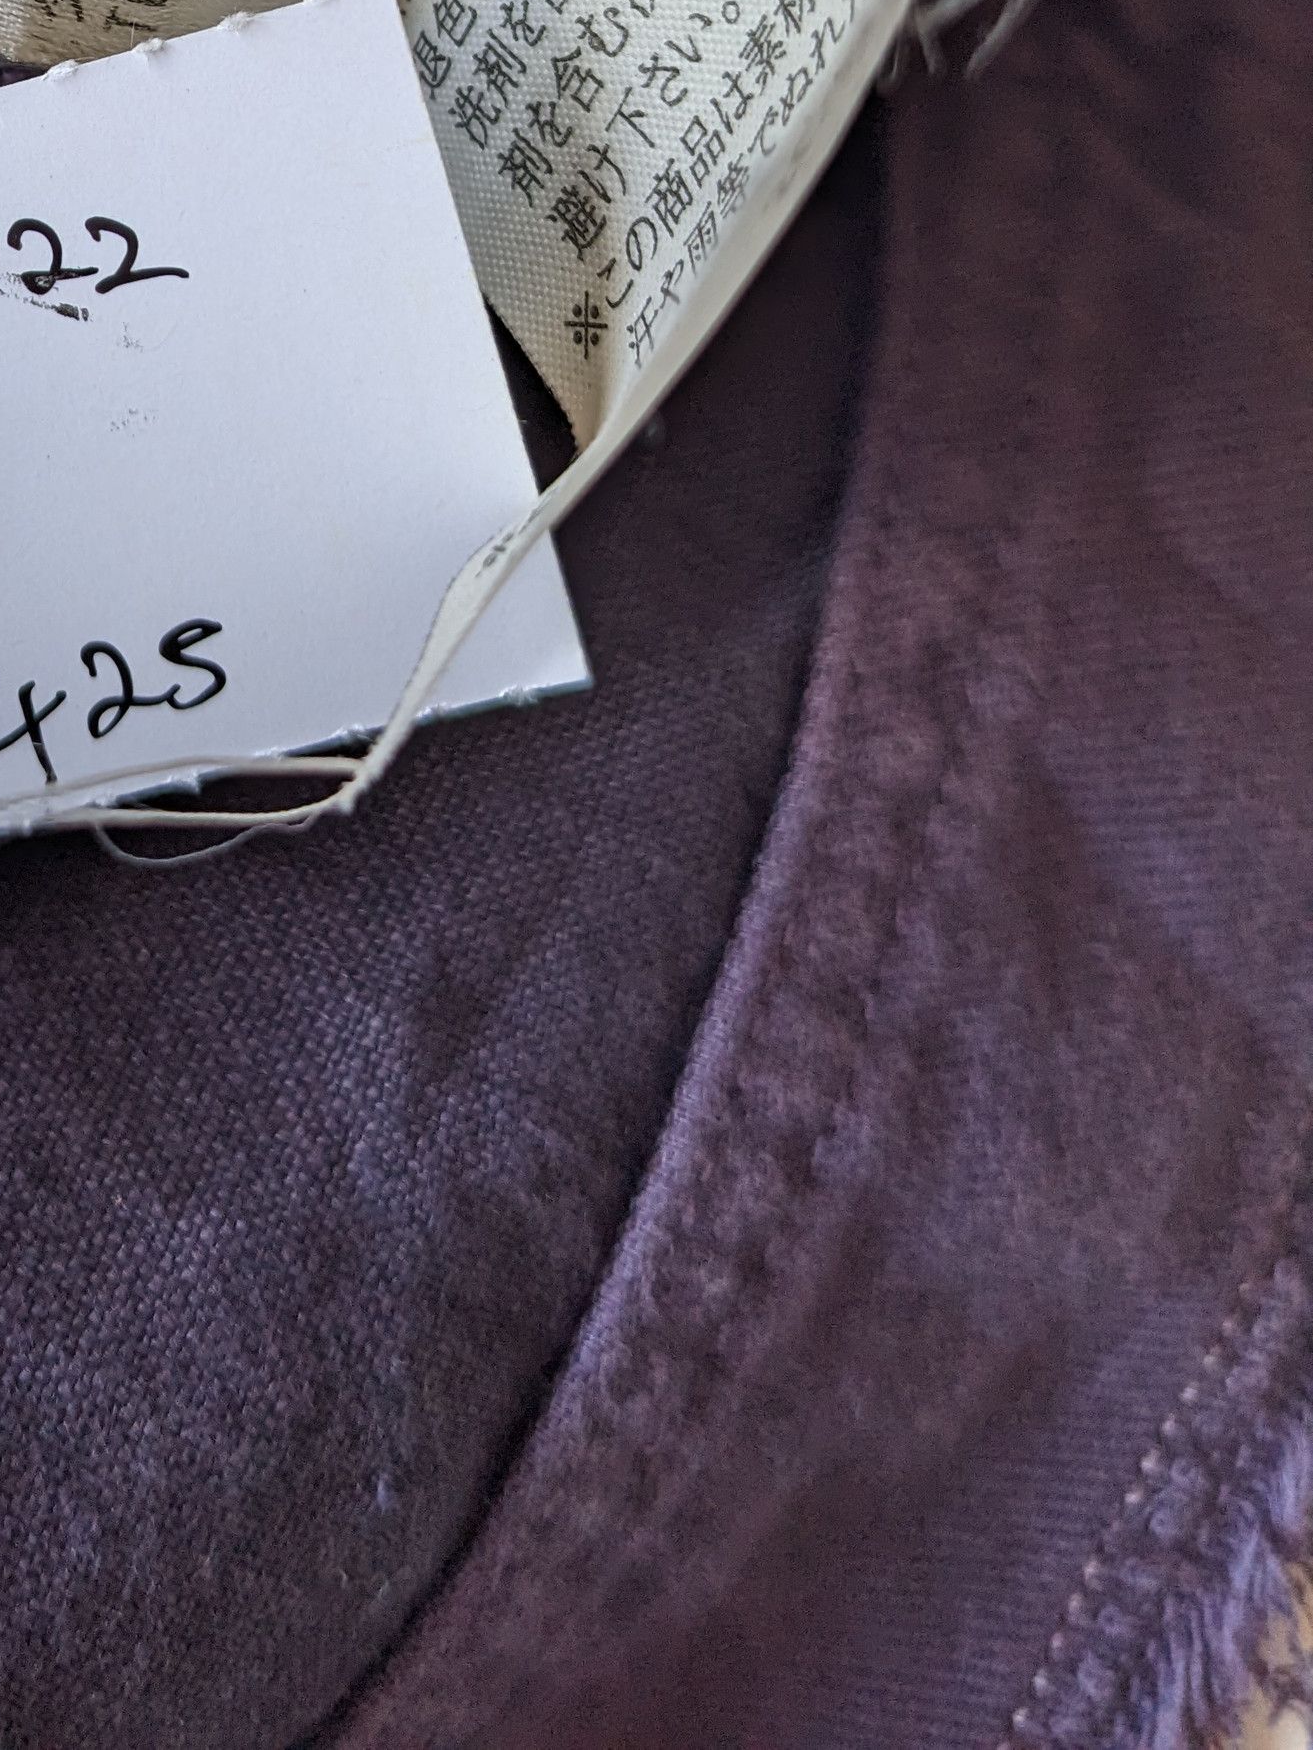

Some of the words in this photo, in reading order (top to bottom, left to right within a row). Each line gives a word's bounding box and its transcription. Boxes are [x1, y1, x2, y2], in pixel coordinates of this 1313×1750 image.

[545, 0, 737, 262] 避け下さい。
